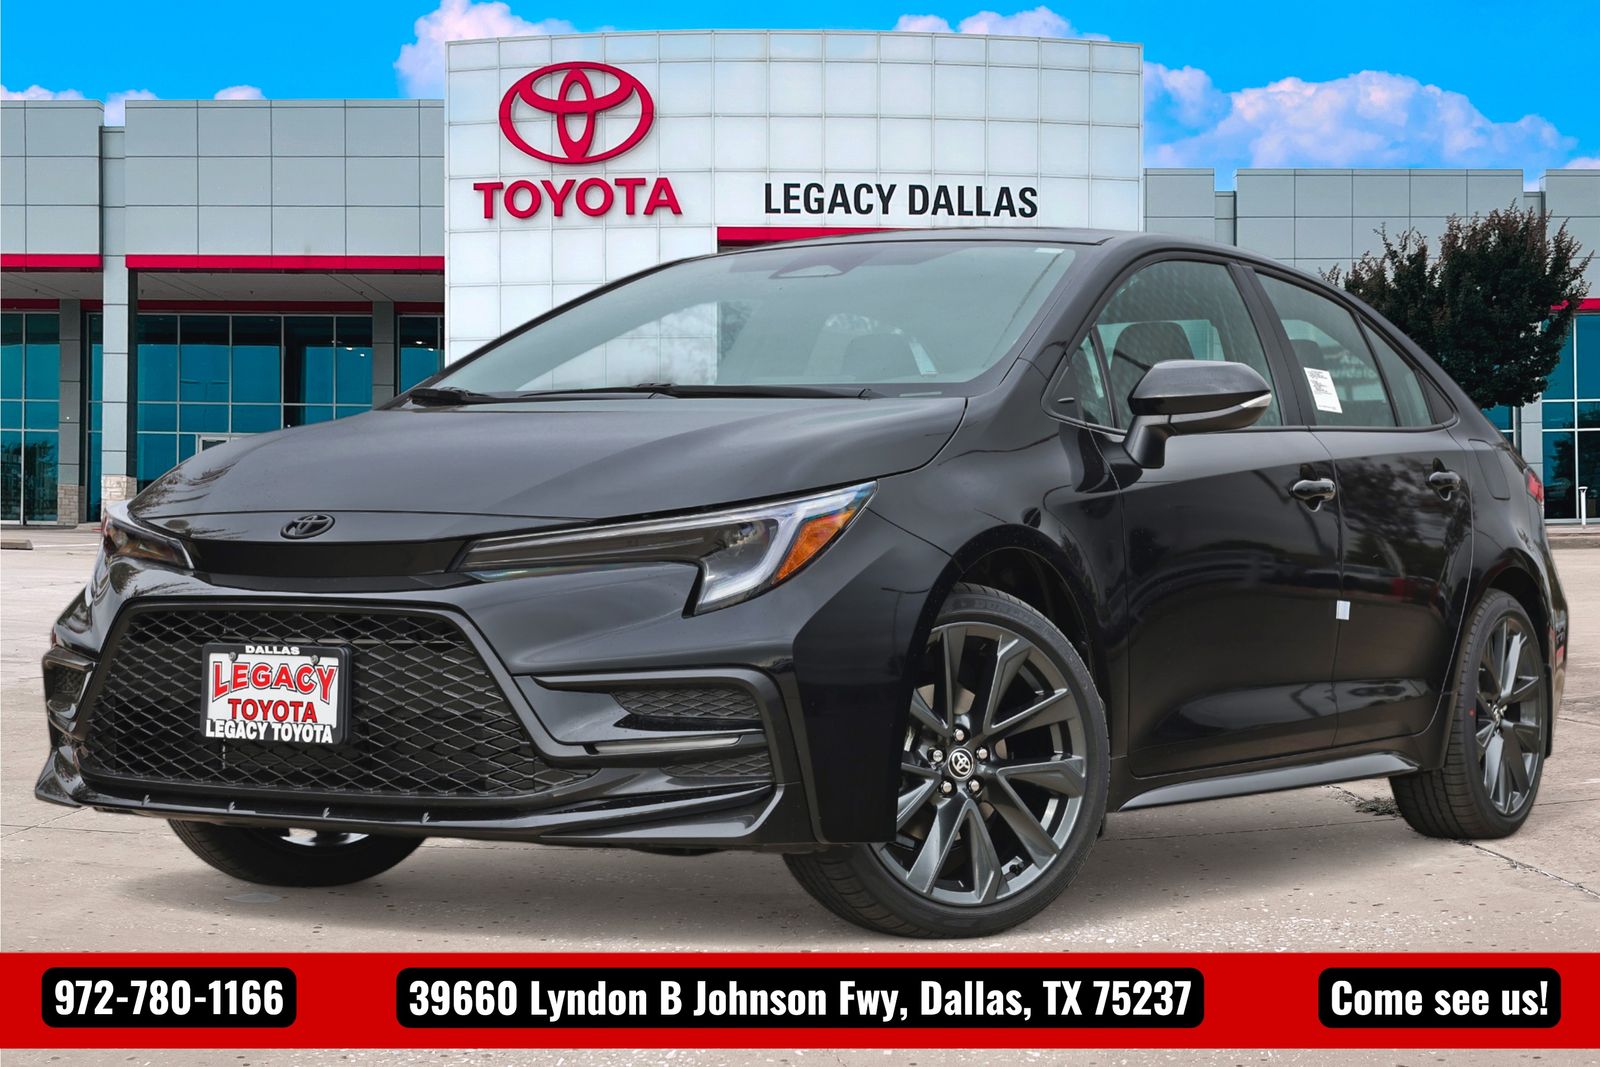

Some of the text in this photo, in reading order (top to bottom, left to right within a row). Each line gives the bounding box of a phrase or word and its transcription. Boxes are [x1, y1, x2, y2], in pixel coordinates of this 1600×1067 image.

[474, 177, 682, 219] TOYOTA
[764, 183, 1038, 218] LEGACY DALLAS
[245, 645, 301, 656] DALLAS
[212, 661, 338, 705] LEGACY
[228, 698, 318, 723] TOYOTA
[205, 719, 333, 743] LEGACY TOYOTA
